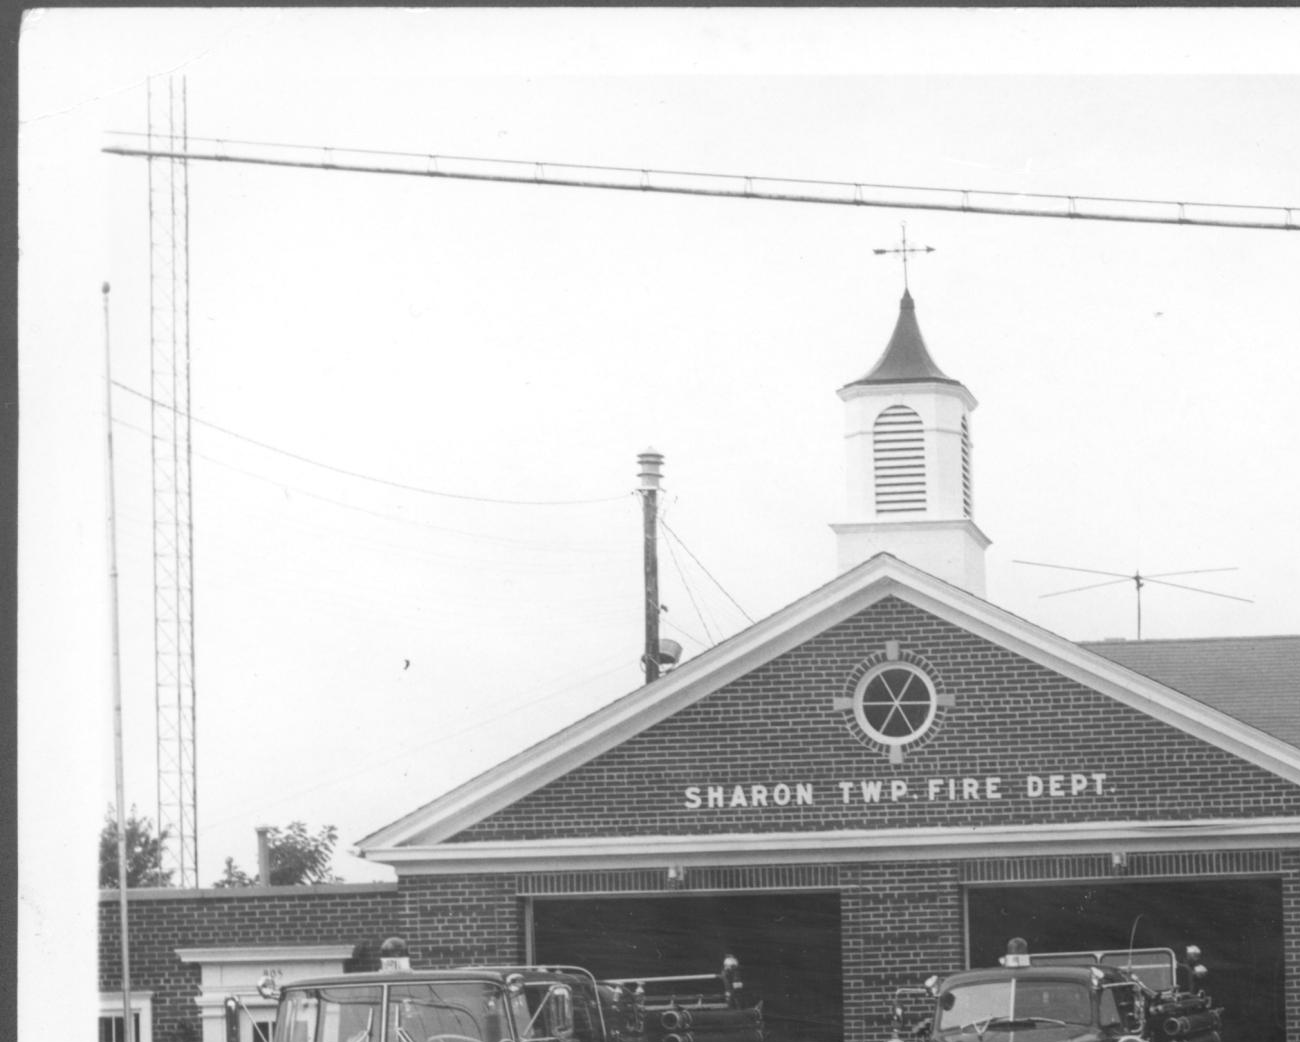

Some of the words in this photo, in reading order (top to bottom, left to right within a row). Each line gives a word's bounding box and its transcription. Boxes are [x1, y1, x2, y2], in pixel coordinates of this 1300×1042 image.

[684, 783, 814, 809] SHARON
[928, 777, 1002, 801] FIRE
[1026, 773, 1117, 798] DEPT.
